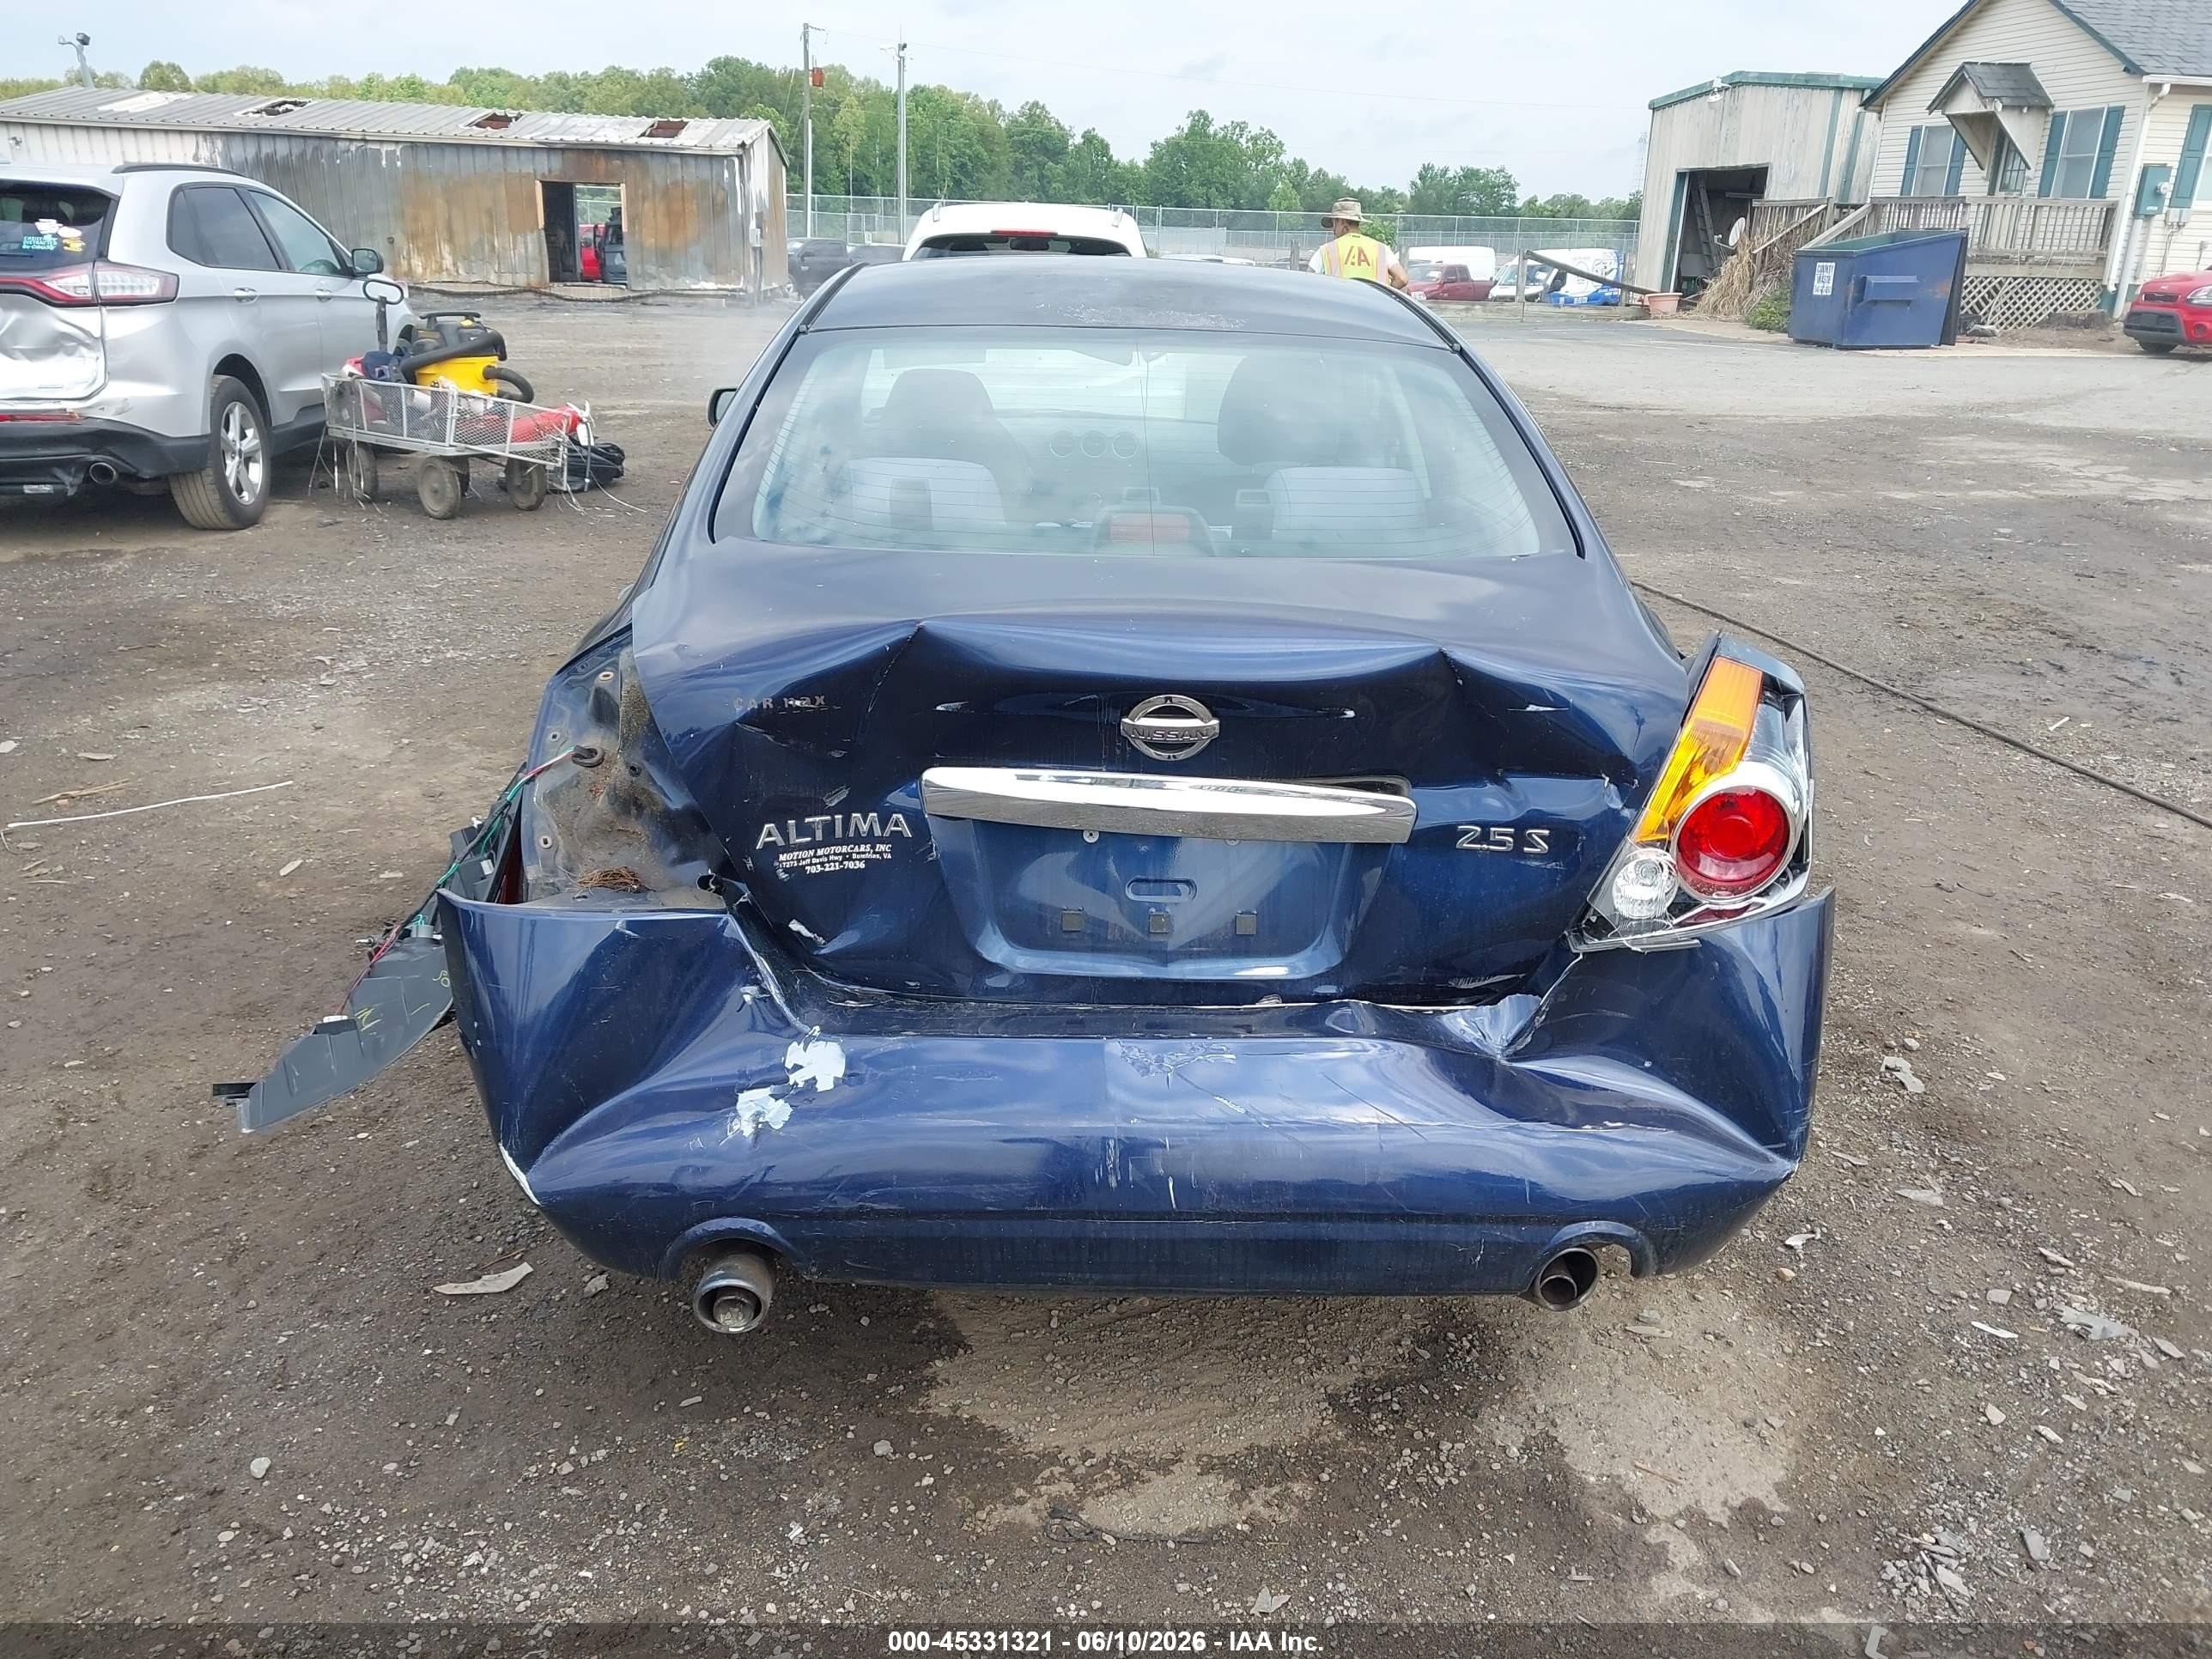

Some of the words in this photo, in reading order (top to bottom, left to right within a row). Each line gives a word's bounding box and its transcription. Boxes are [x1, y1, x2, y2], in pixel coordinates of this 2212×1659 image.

[1131, 727, 1209, 741] NISSAN
[756, 812, 913, 850] ALTIMA
[779, 849, 814, 861] MOTION
[817, 843, 873, 855] MOTORCARS,
[875, 844, 892, 853] INC
[805, 860, 866, 874] 703-221-7036
